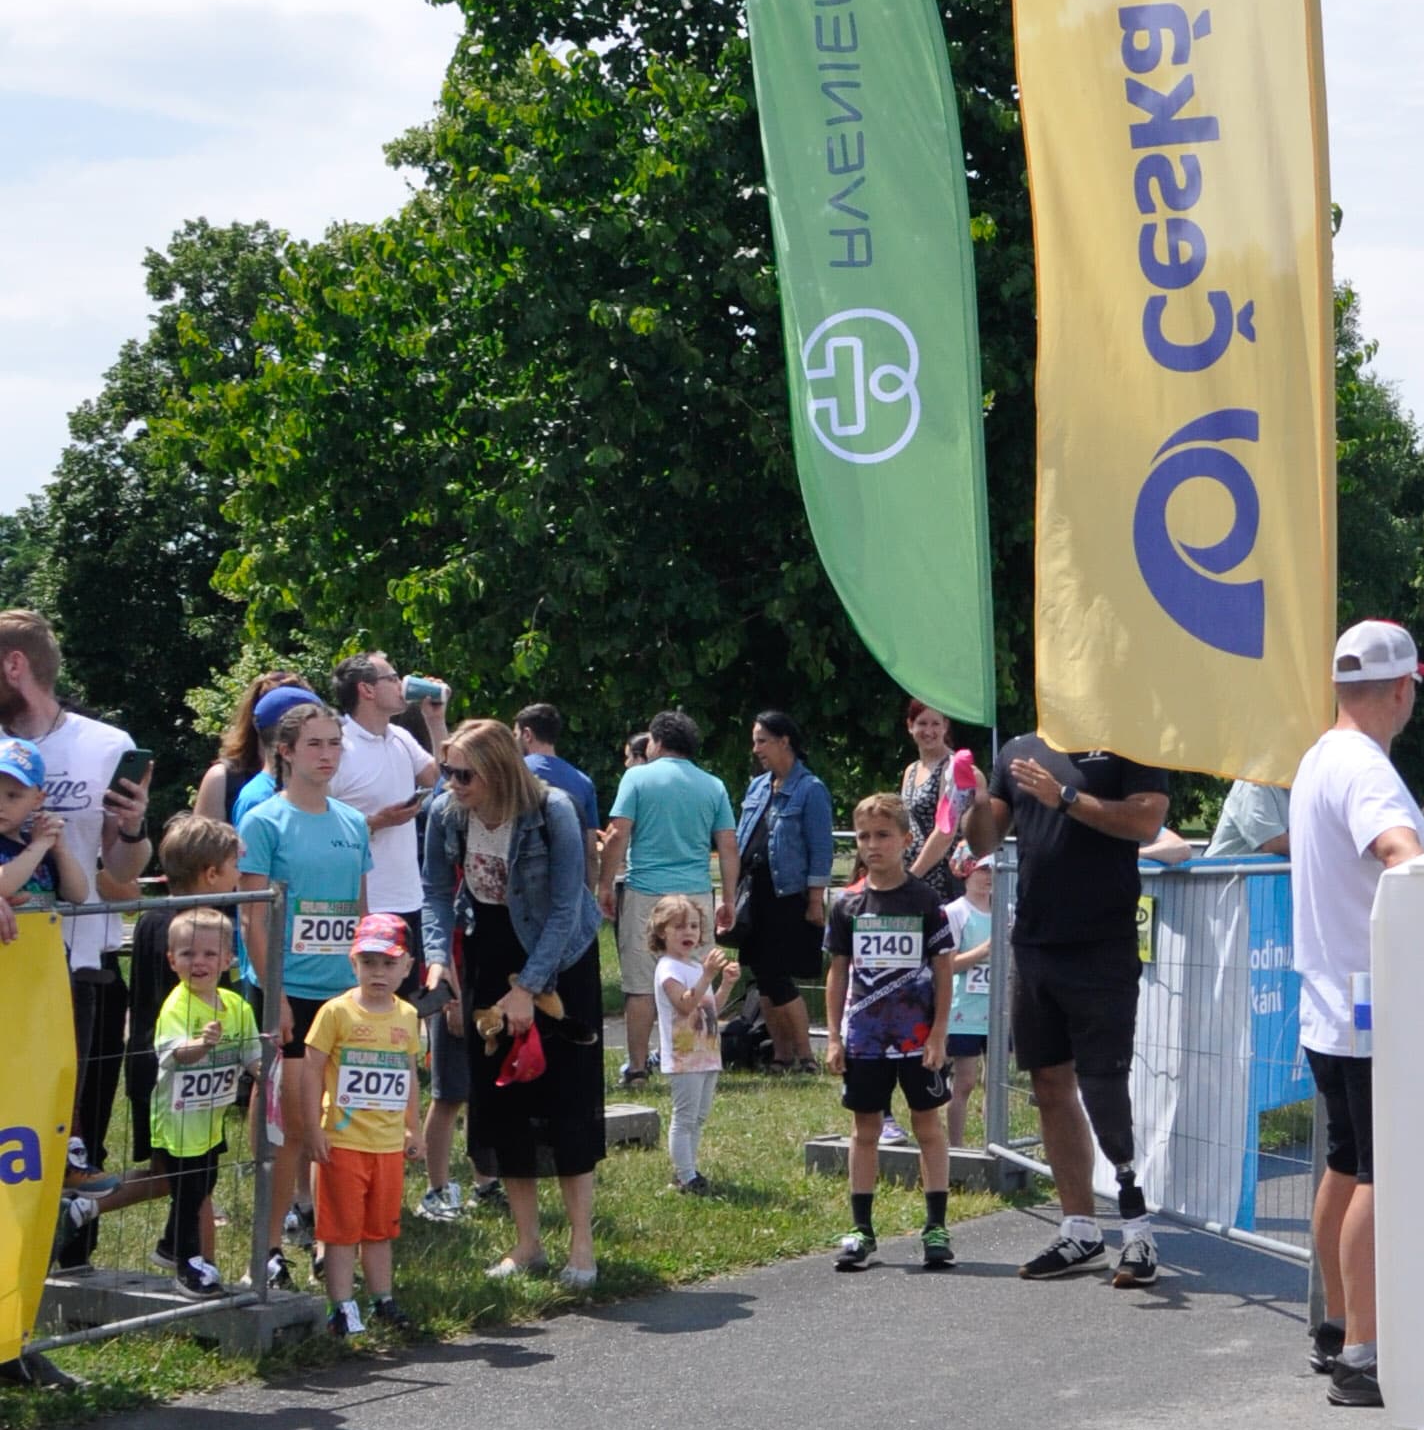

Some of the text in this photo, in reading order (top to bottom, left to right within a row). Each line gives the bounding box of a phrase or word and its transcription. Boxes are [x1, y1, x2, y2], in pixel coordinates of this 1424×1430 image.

[43, 779, 87, 805] age
[301, 919, 355, 941] 2006
[860, 935, 913, 956] 2140
[972, 966, 991, 984] 20
[181, 1069, 235, 1098] 2079
[347, 1070, 405, 1096] 2076
